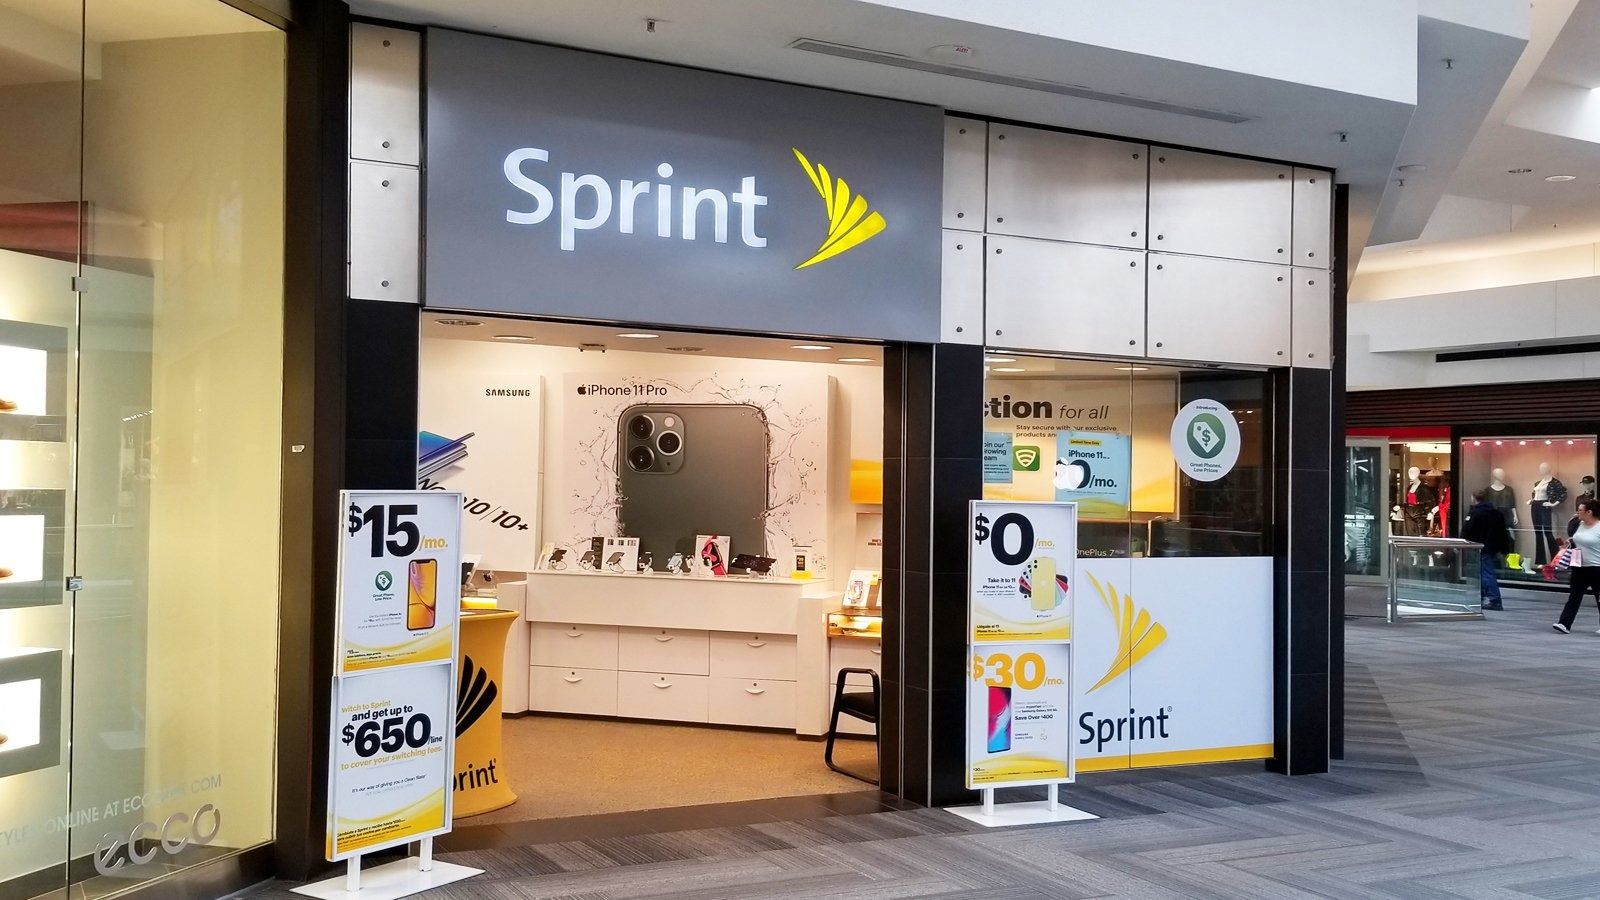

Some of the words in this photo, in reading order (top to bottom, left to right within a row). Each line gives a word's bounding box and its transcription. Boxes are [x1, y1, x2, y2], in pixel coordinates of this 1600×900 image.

[503, 147, 768, 252] Sprint
[485, 388, 531, 397] SAMSUNG
[587, 384, 631, 396] iPhone
[632, 384, 643, 396] 11
[646, 384, 668, 396] Pro
[984, 394, 1053, 419] tion
[1059, 405, 1084, 419] for
[1088, 405, 1110, 420] all
[1068, 449, 1095, 459] iPhone
[351, 709, 371, 722] and
[372, 707, 389, 720] get
[389, 706, 402, 717] up
[403, 704, 414, 713] to
[370, 700, 391, 710] Sprint
[341, 761, 349, 771] to
[350, 757, 372, 769] cover
[373, 755, 390, 766] your
[391, 747, 426, 761] switching
[45, 806, 99, 835] ONLINE
[103, 800, 120, 820] AT
[93, 803, 222, 877] ecco
